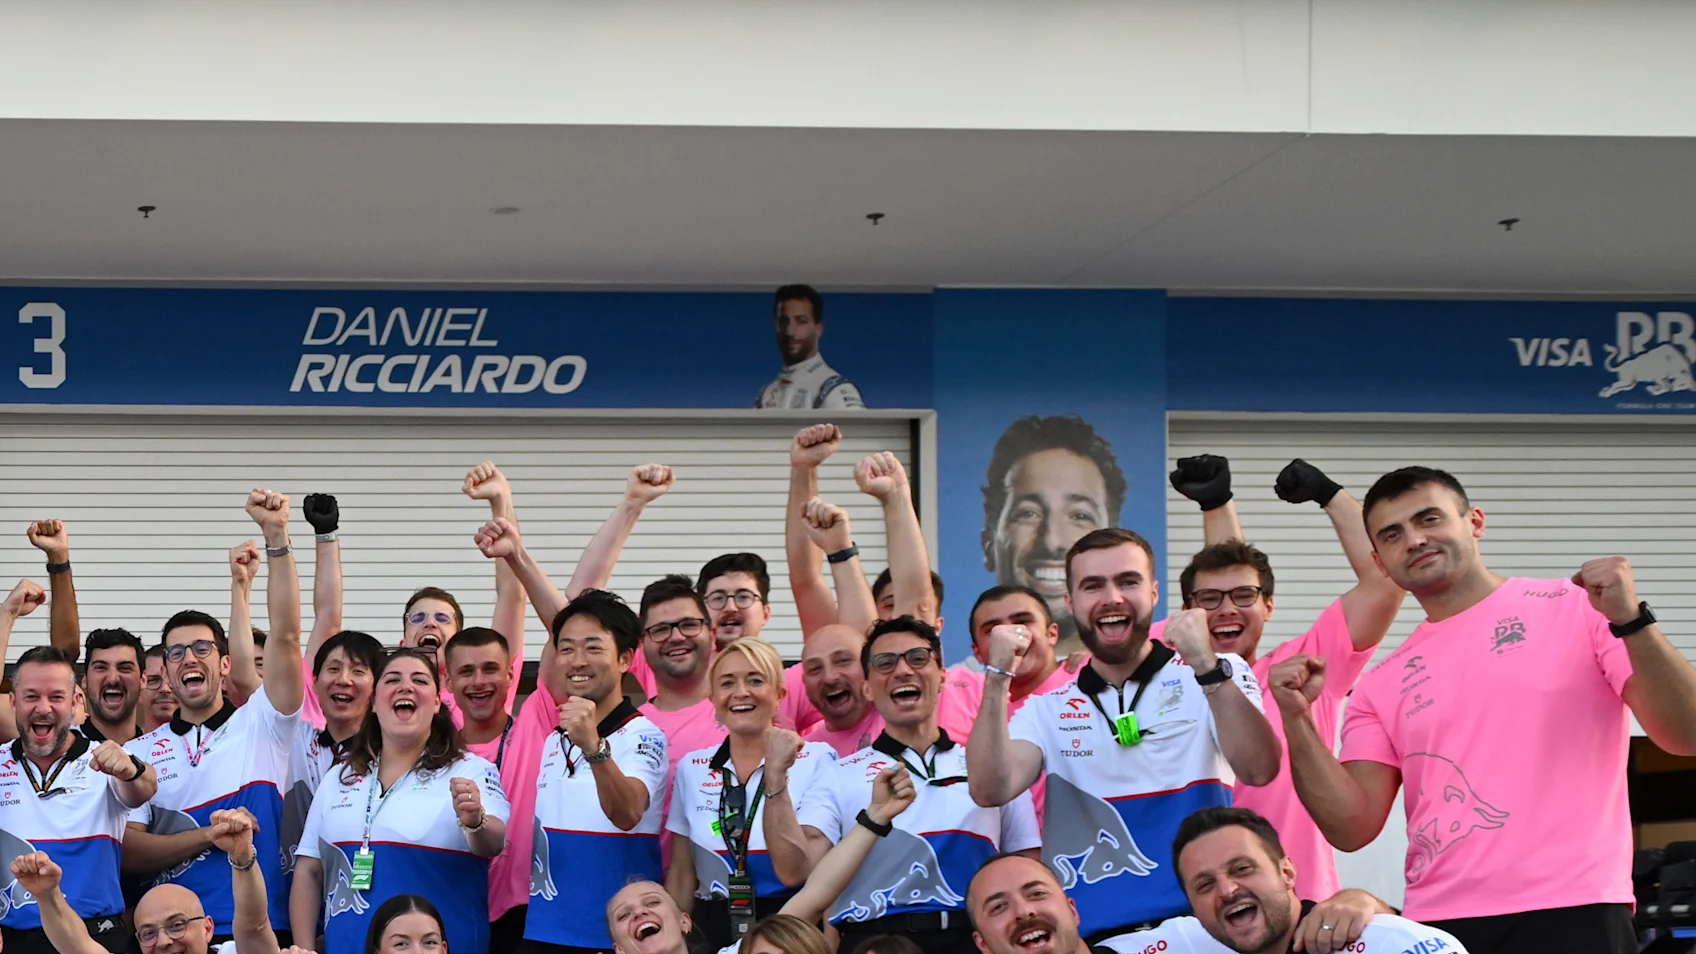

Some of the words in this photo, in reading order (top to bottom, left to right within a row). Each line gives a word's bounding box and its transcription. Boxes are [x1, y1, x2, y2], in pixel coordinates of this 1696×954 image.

[302, 306, 499, 347] DANIEL
[18, 302, 66, 390] 3
[1508, 337, 1594, 367] VISA
[289, 354, 587, 395] RICCIARDO
[1523, 588, 1569, 598] HUGO
[1497, 616, 1520, 625] VISA
[1161, 678, 1182, 687] VISA
[151, 748, 174, 757] ORLEN
[1060, 749, 1094, 757] TUDOR
[692, 757, 713, 765] HUG
[157, 773, 179, 783] UDOR
